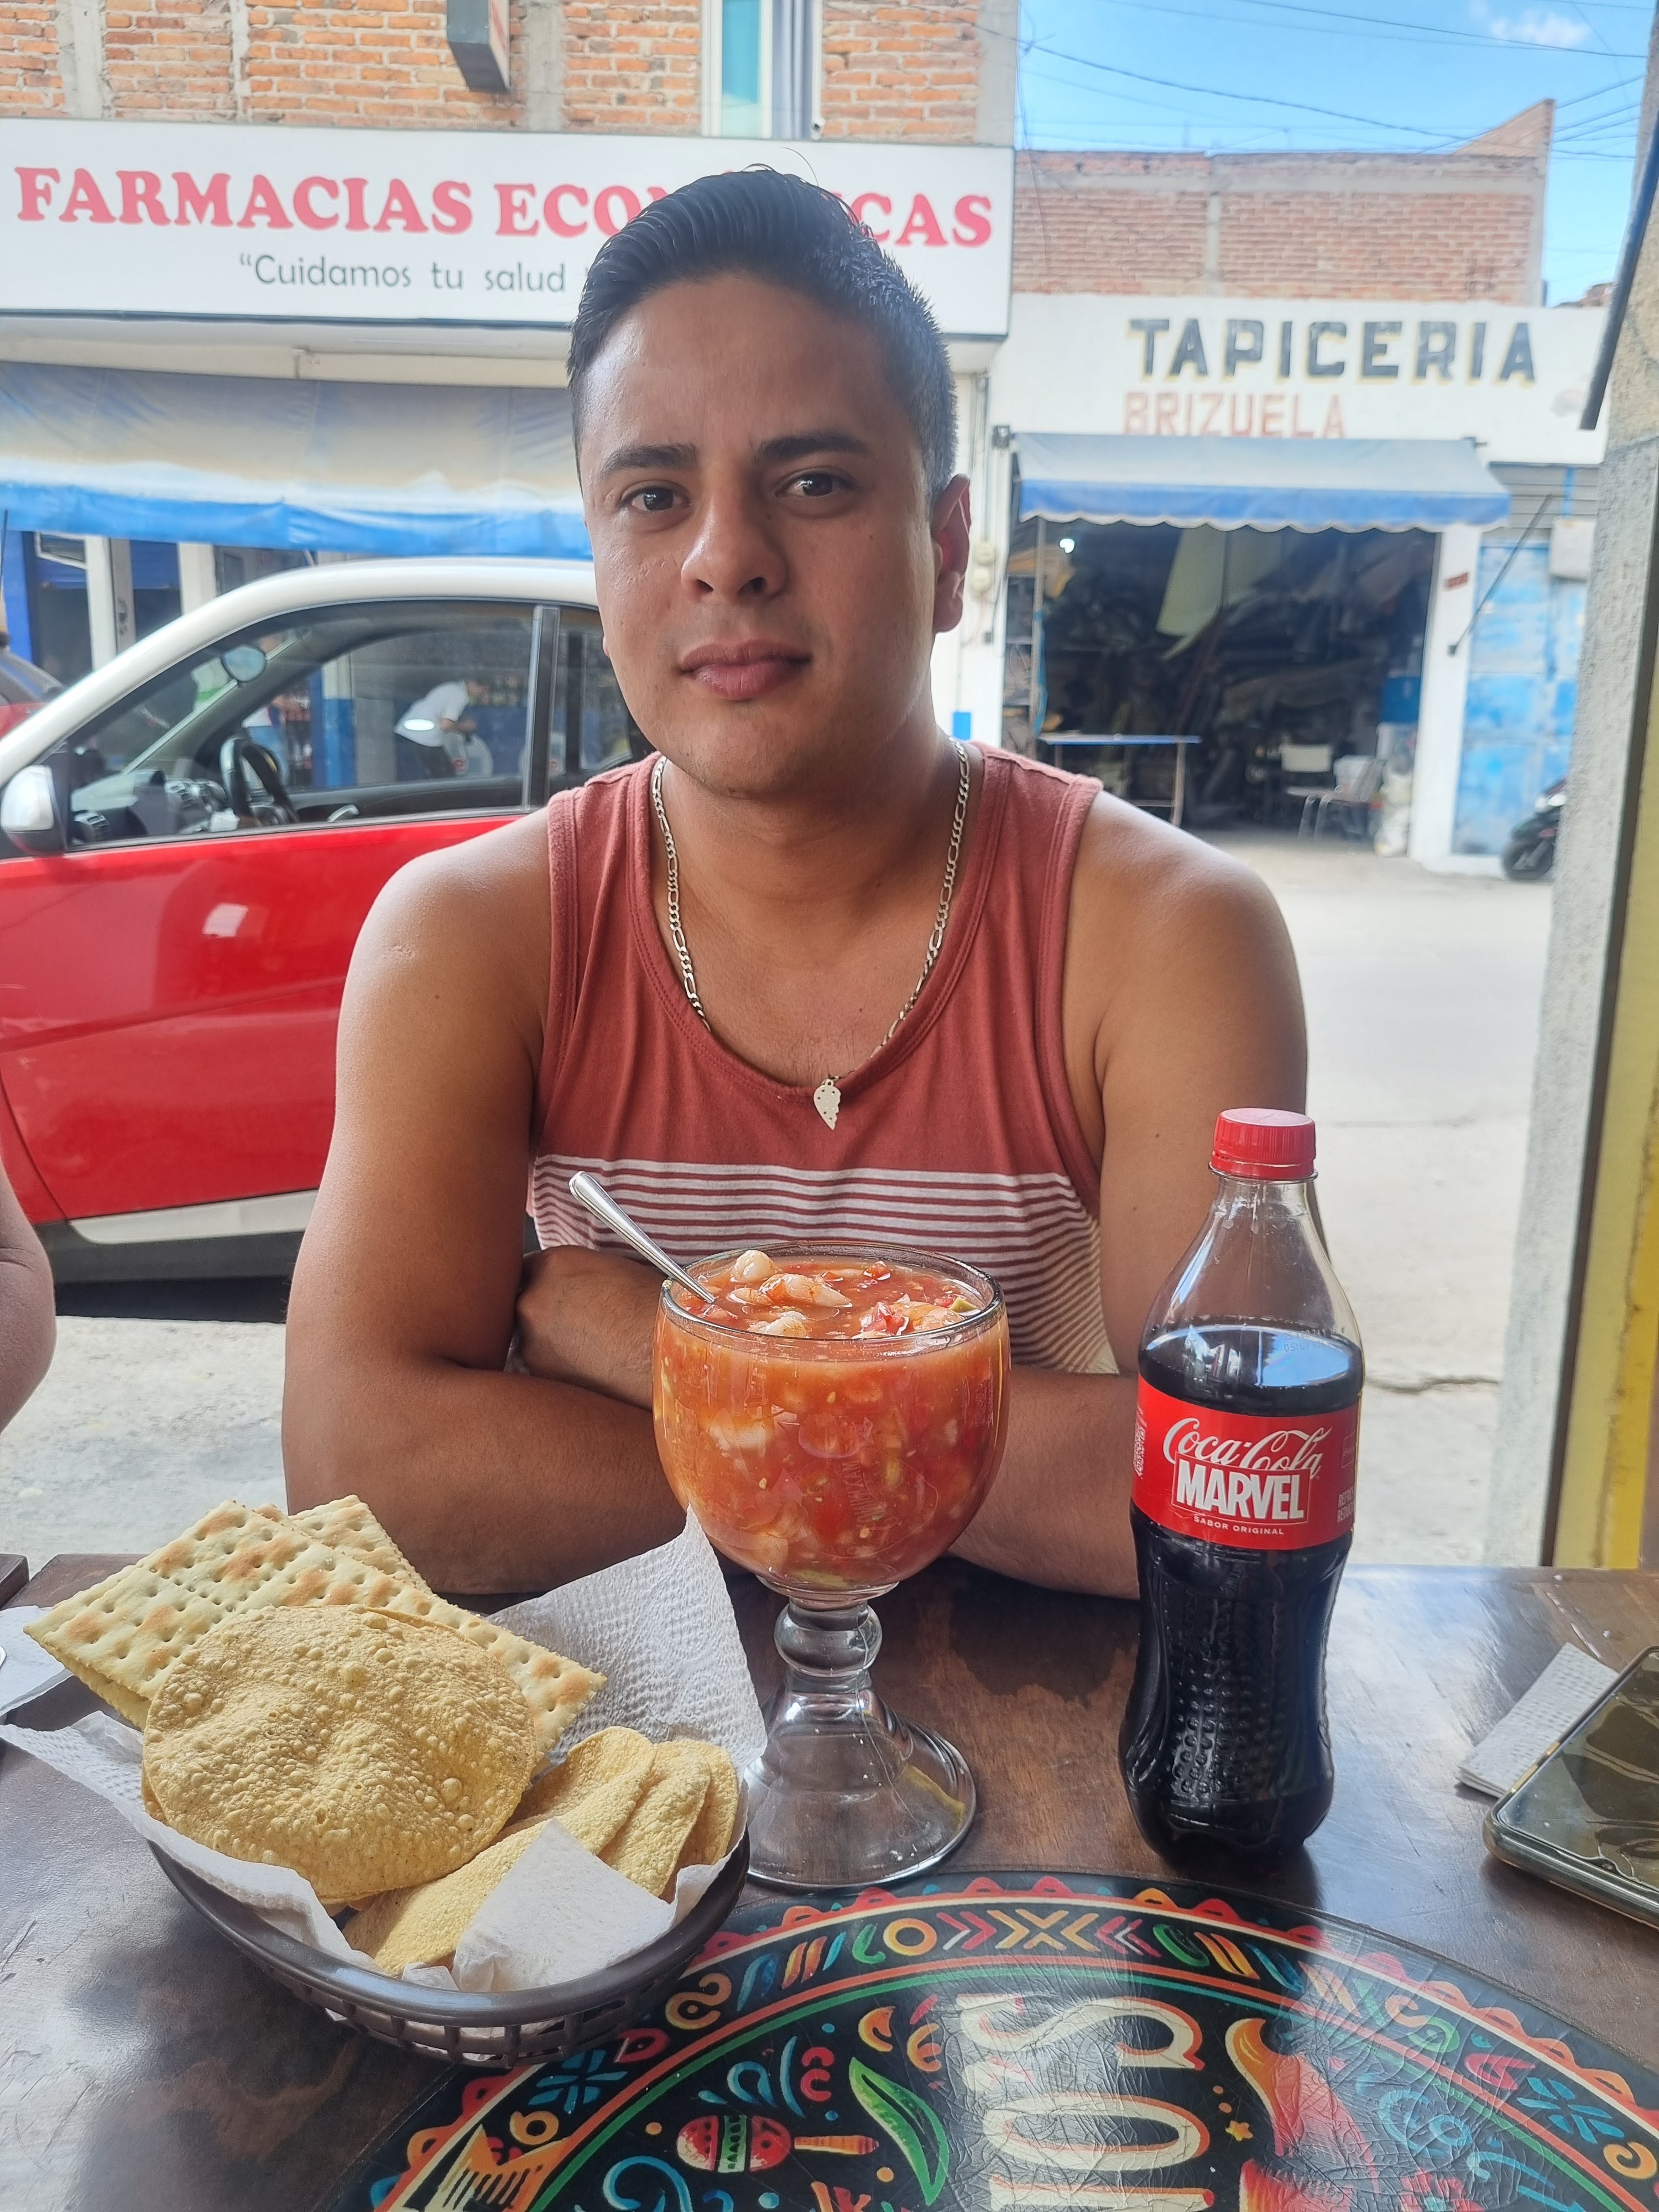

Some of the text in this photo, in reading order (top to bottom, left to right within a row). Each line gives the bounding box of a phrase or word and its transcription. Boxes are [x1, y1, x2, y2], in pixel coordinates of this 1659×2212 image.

[14, 166, 992, 247] FARMACIAS ECOCAS
[431, 262, 465, 291] tu
[484, 261, 565, 293] salud
[1126, 318, 1536, 384] TAPICERIA
[1123, 391, 1346, 439] BRIZUELA
[1163, 1417, 1332, 1479] Coca-Cola
[1176, 1458, 1305, 1520] MARVEL
[1193, 1515, 1285, 1536] SABOR ORIGINAL
